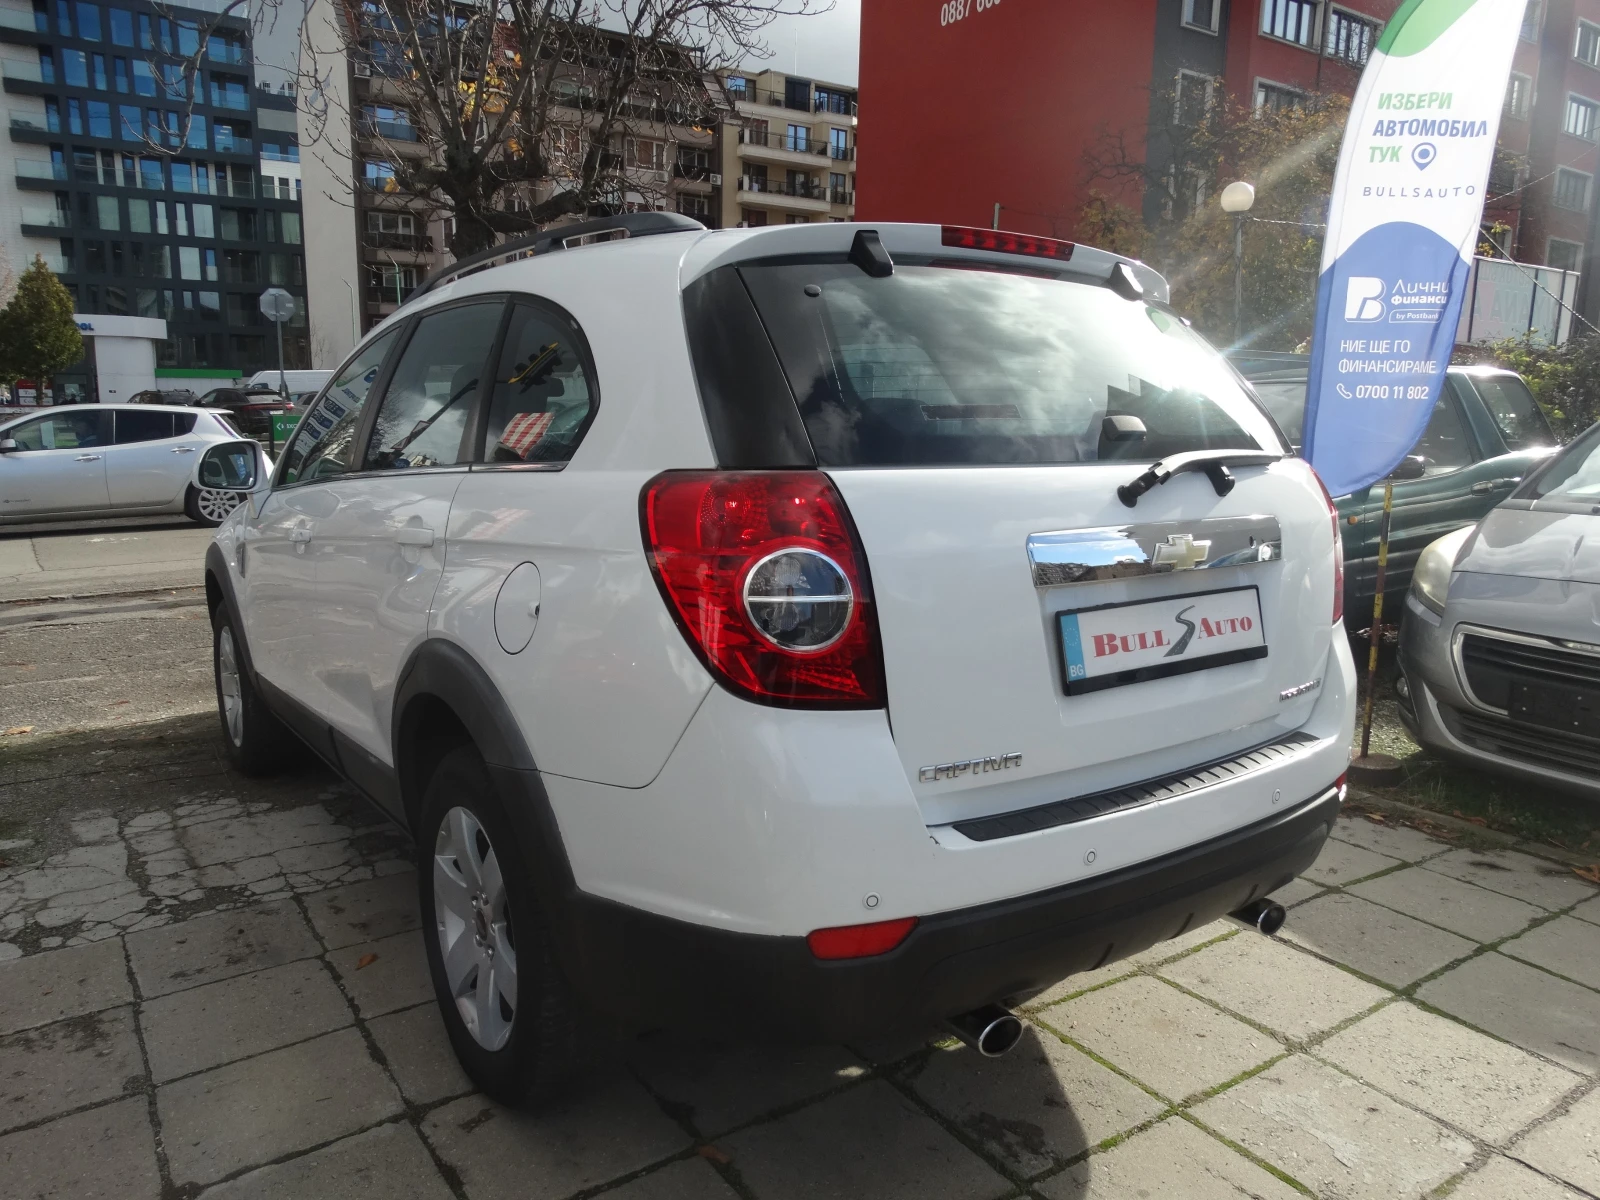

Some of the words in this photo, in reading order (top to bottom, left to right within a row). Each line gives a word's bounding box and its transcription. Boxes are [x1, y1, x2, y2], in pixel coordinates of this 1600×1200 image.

[1377, 92, 1453, 110] ИЗБЕРИ
[1372, 119, 1488, 138] АВТОМОБИЛ
[1369, 145, 1403, 163] ТУК
[1363, 185, 1475, 198] BULLSAUTO
[1391, 279, 1450, 294] Лични
[1390, 294, 1448, 305] Финанси
[1406, 312, 1439, 320] Postbank
[1340, 339, 1366, 353] НИЕ
[1369, 339, 1391, 355] ЩЕ
[1393, 339, 1411, 353] ГО
[1338, 358, 1437, 374] ФИНАНСИРАМЕ
[1356, 385, 1389, 399] 0700
[1393, 385, 1404, 399] 11
[1407, 385, 1429, 400] 802
[1091, 629, 1171, 658] BULL
[1197, 615, 1253, 640] AUTO
[1070, 664, 1084, 677] BG
[918, 752, 1023, 783] CAPTIVA
